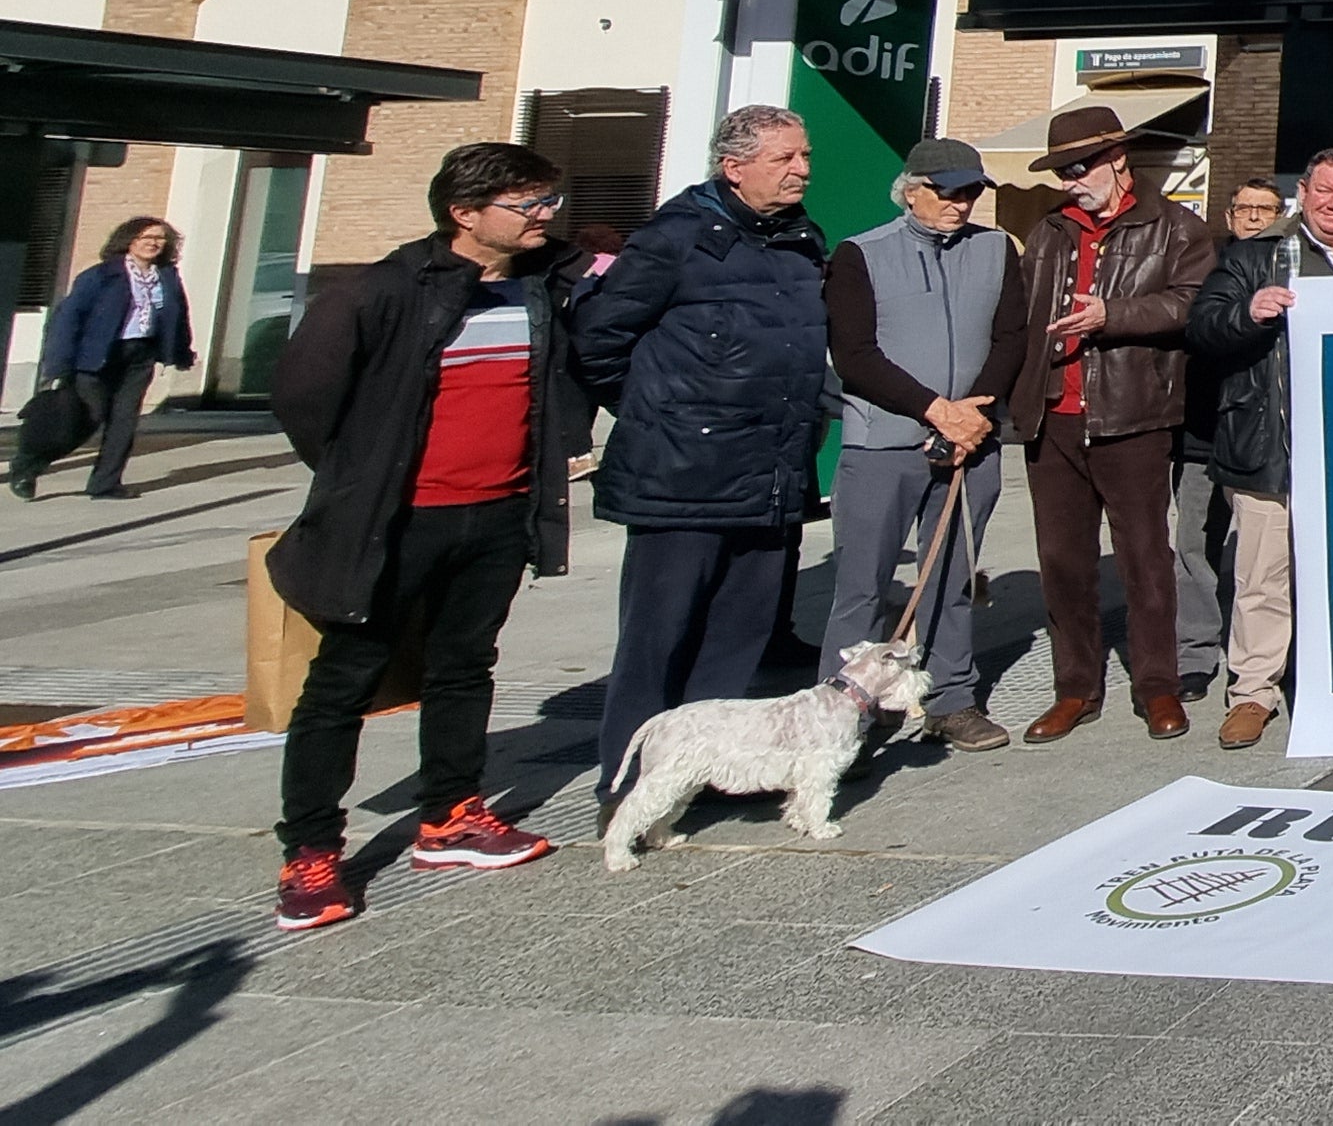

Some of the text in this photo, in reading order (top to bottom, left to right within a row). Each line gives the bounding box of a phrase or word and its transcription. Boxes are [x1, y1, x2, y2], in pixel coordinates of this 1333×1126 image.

[802, 35, 919, 81] adif
[1095, 848, 1320, 897] TREN RUTA DE LA PLATA
[1085, 910, 1221, 930] Movimiento
